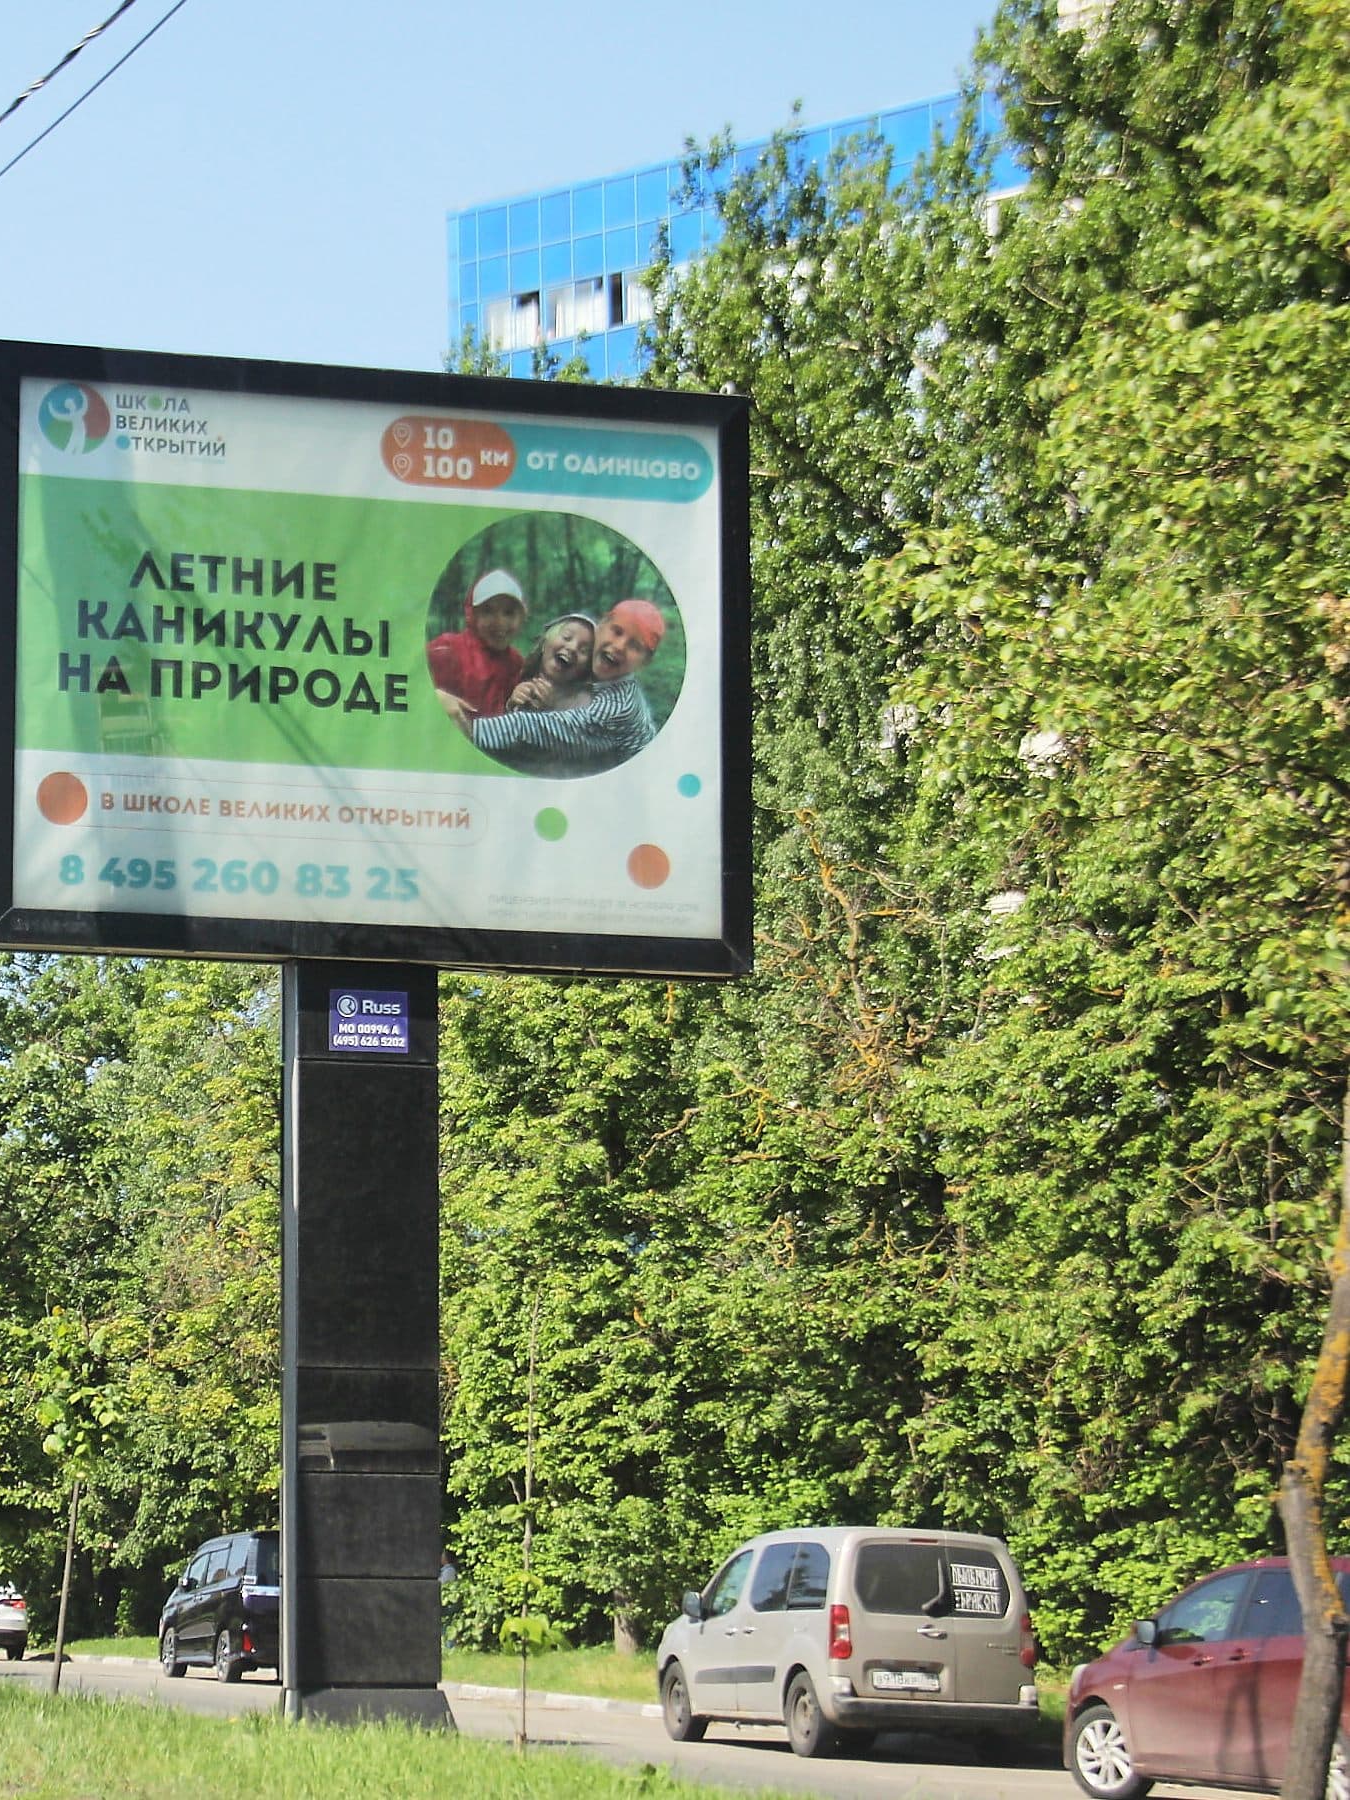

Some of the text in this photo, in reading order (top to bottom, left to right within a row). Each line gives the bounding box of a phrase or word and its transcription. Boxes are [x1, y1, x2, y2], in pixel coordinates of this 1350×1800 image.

[115, 414, 208, 435] ВЕЛИКИХ
[422, 425, 454, 450] 10
[422, 454, 473, 480] 100
[527, 450, 700, 482] ОТ ОДИНЦОВО
[129, 550, 337, 601] ЛЕТНИЕ
[77, 599, 390, 658] КАНИКУЛЫ
[58, 652, 409, 714] НА ПРИРОДЕ
[101, 792, 471, 830] В ШКОЛЕ ВЕЛИКИХ ОТКРЫТИЙ
[59, 854, 420, 903] 8 495 260 83 25
[362, 1000, 401, 1015] Russ
[333, 1035, 405, 1048] (495) 626 5202
